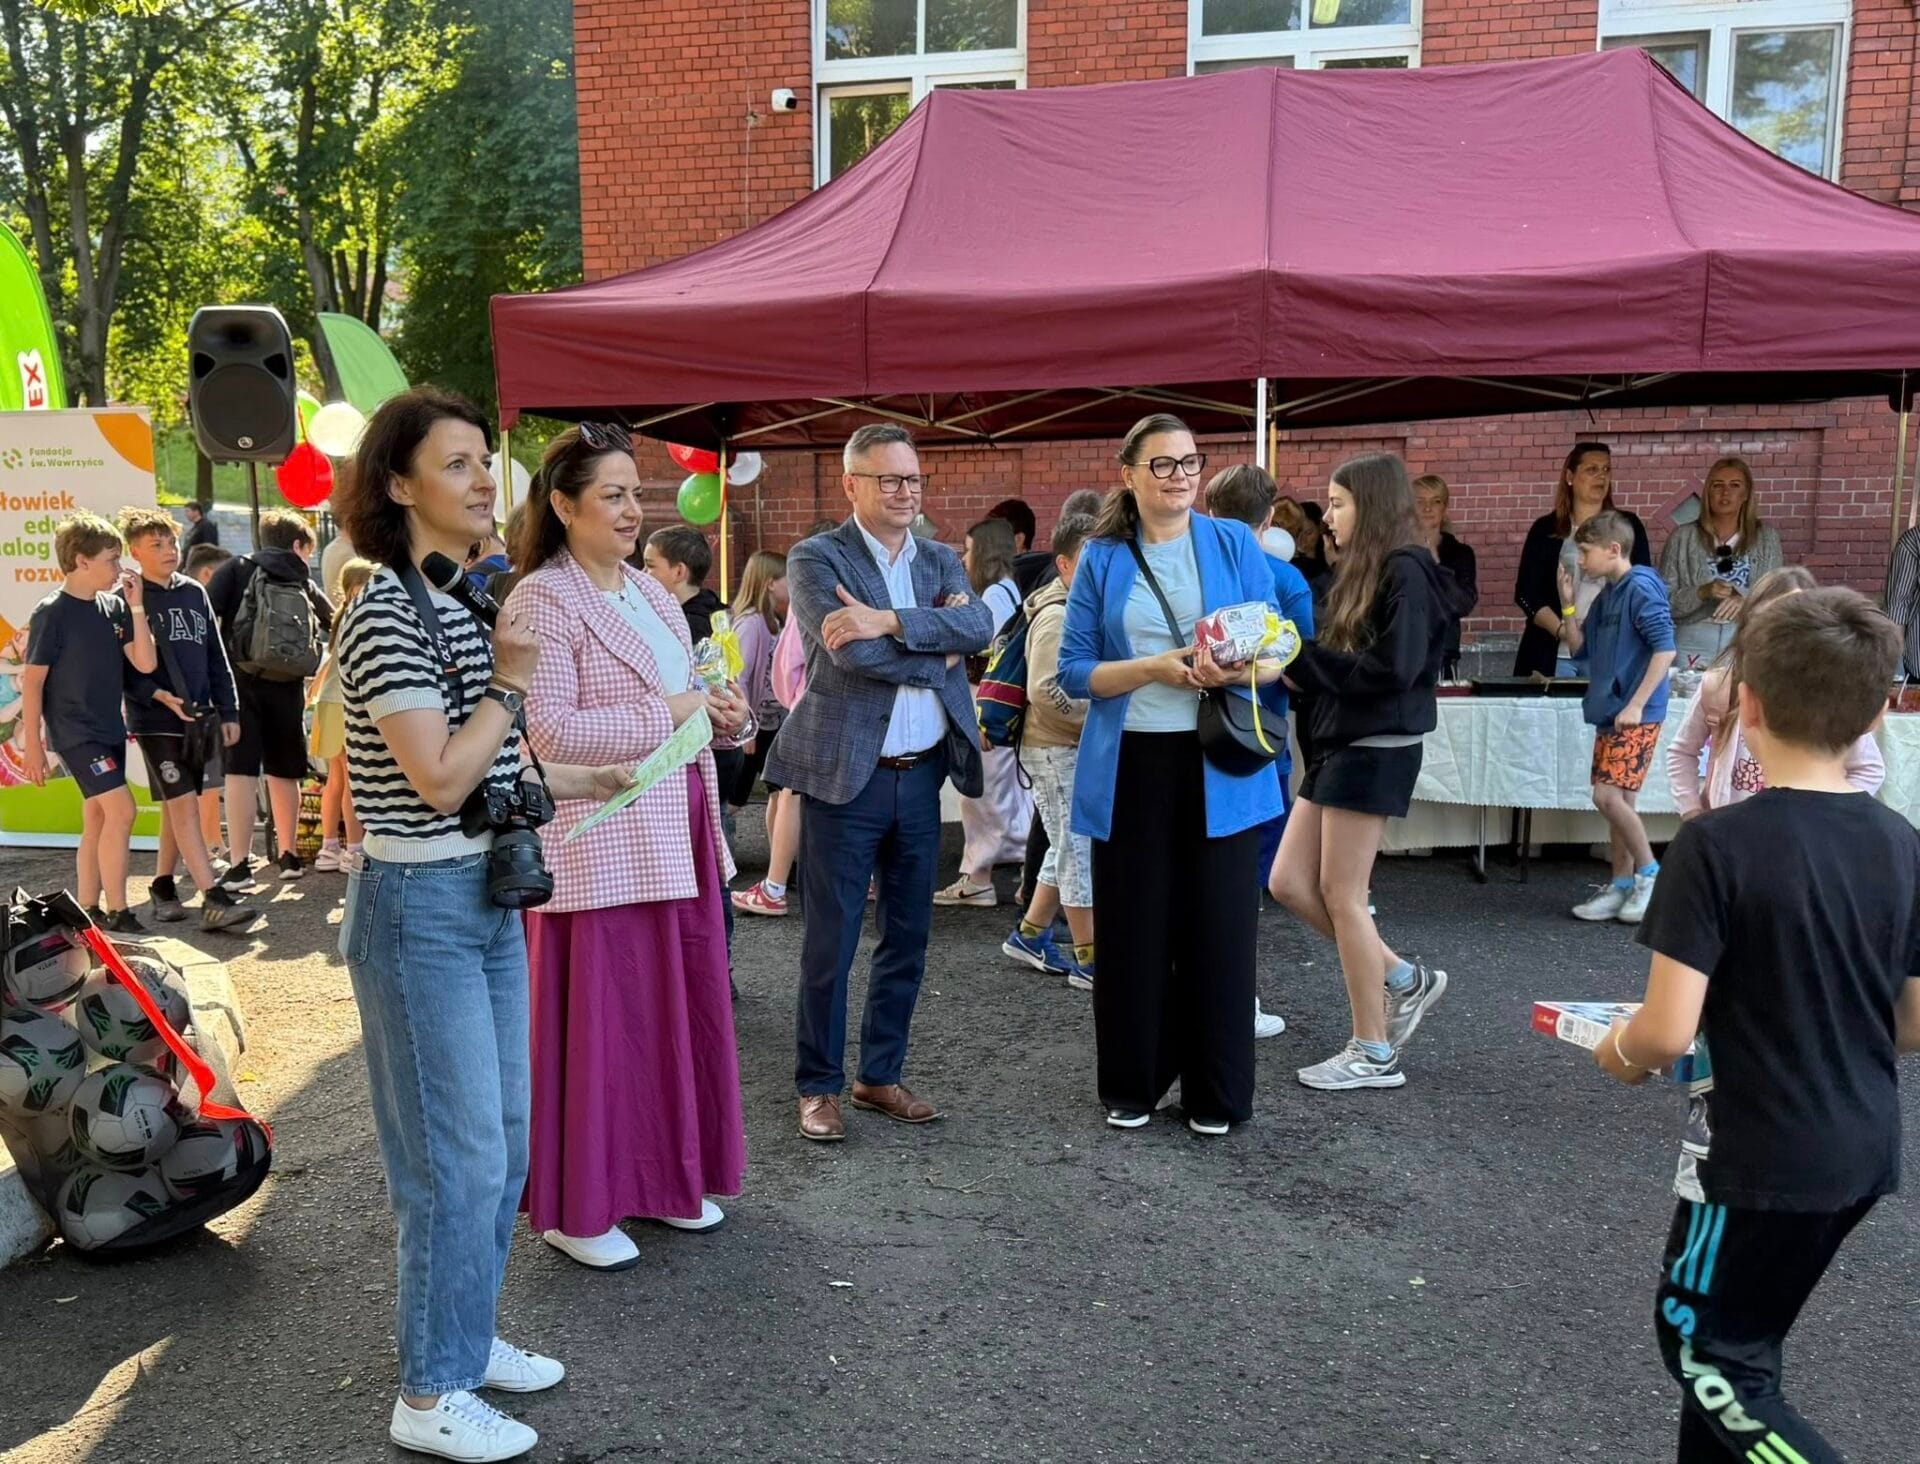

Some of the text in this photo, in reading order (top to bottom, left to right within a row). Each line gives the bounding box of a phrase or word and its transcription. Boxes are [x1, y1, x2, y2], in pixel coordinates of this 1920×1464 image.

[29, 446, 72, 457] Fundacja
[0, 536, 50, 561] alog
[15, 568, 65, 583] rozw
[157, 608, 207, 645] AP
